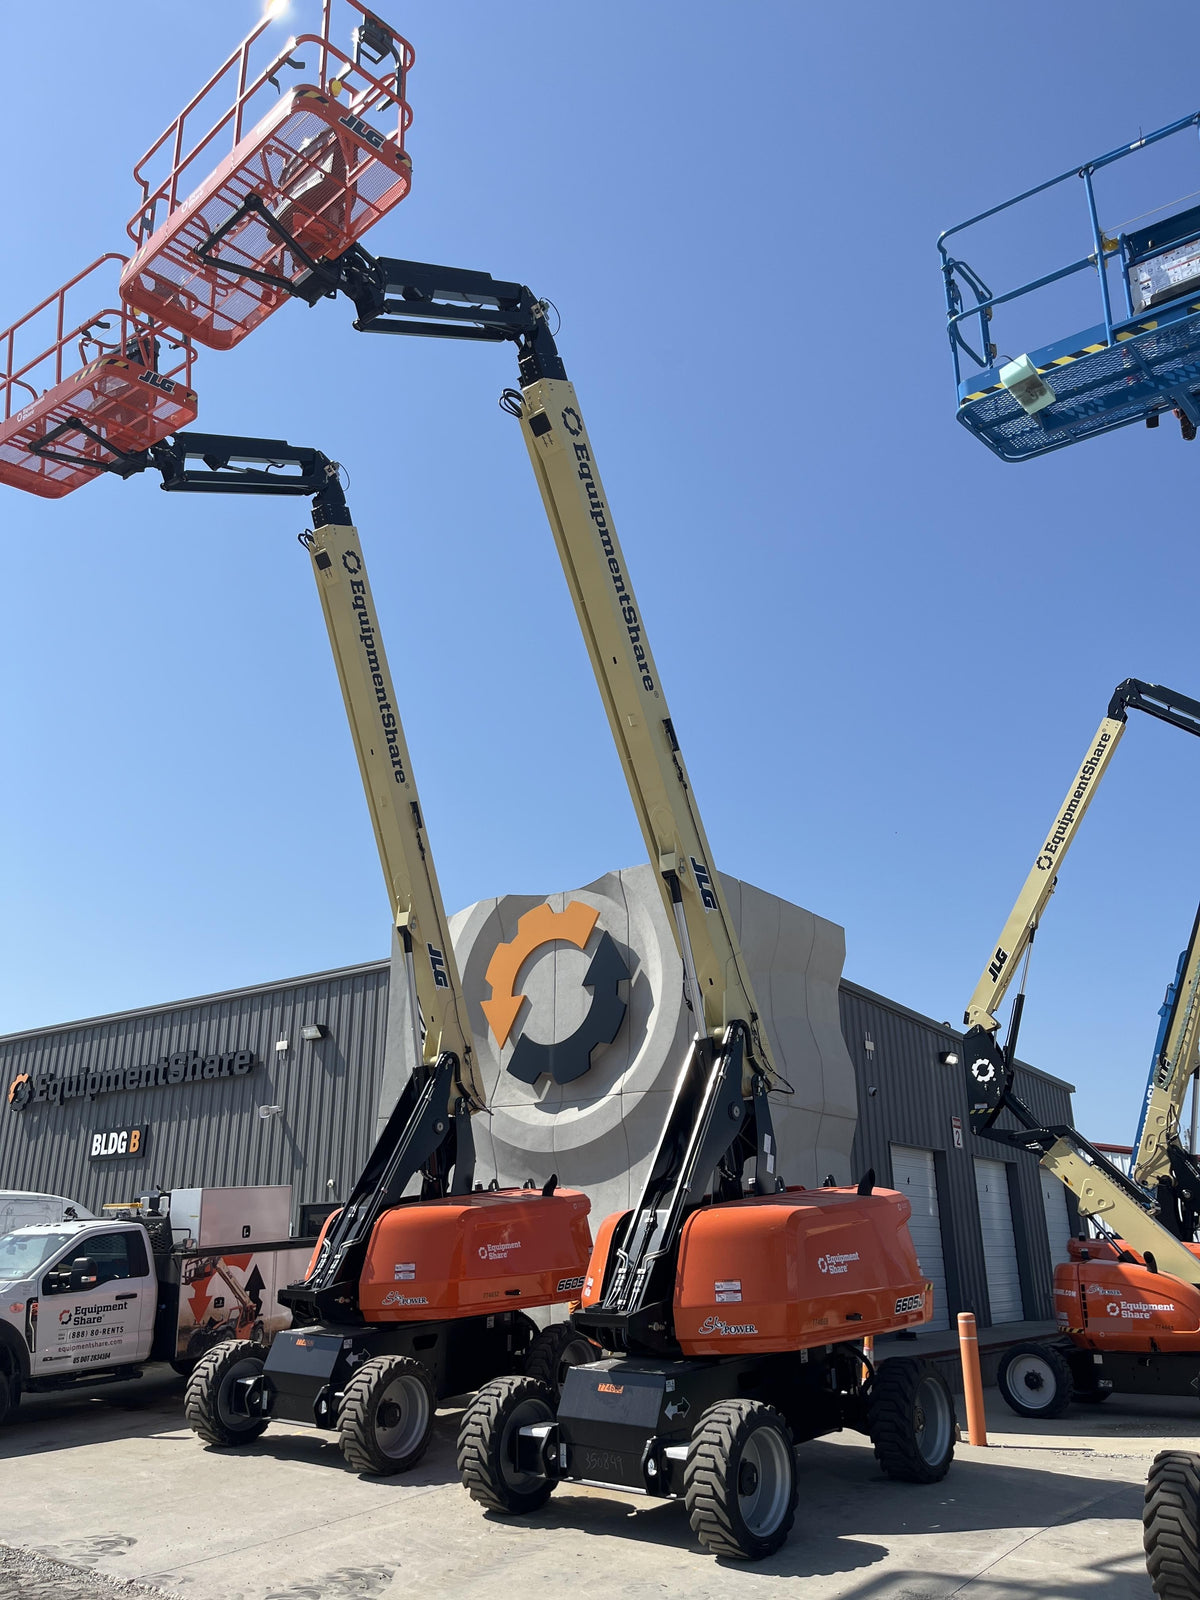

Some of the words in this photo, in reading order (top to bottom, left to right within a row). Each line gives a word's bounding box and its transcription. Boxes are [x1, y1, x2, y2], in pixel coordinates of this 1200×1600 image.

[338, 114, 387, 150] JLG
[139, 371, 176, 394] JLG
[572, 441, 655, 692] EquipmentShare
[350, 579, 406, 784] EquipmentShare
[1044, 732, 1111, 855] EquipmentShare
[690, 856, 718, 910] JLG
[427, 943, 449, 988] JLG
[988, 946, 1009, 983] JLG
[32, 1050, 255, 1106] EquipmentShare
[91, 1131, 128, 1156] BLDG
[129, 1130, 141, 1153] B
[955, 1130, 961, 1146] 2
[487, 1241, 521, 1252] Equipment
[488, 1252, 508, 1260] Share
[825, 1252, 860, 1265] Equipment
[828, 1264, 848, 1274] Share
[74, 1301, 128, 1316] Equipment
[1120, 1301, 1175, 1312] Equipment
[1121, 1310, 1151, 1319] Share
[73, 1315, 103, 1326] Share
[68, 1330, 88, 1339] (888)
[90, 1326, 124, 1337] 80-RENTS
[58, 1338, 123, 1352] equipmentshare.com
